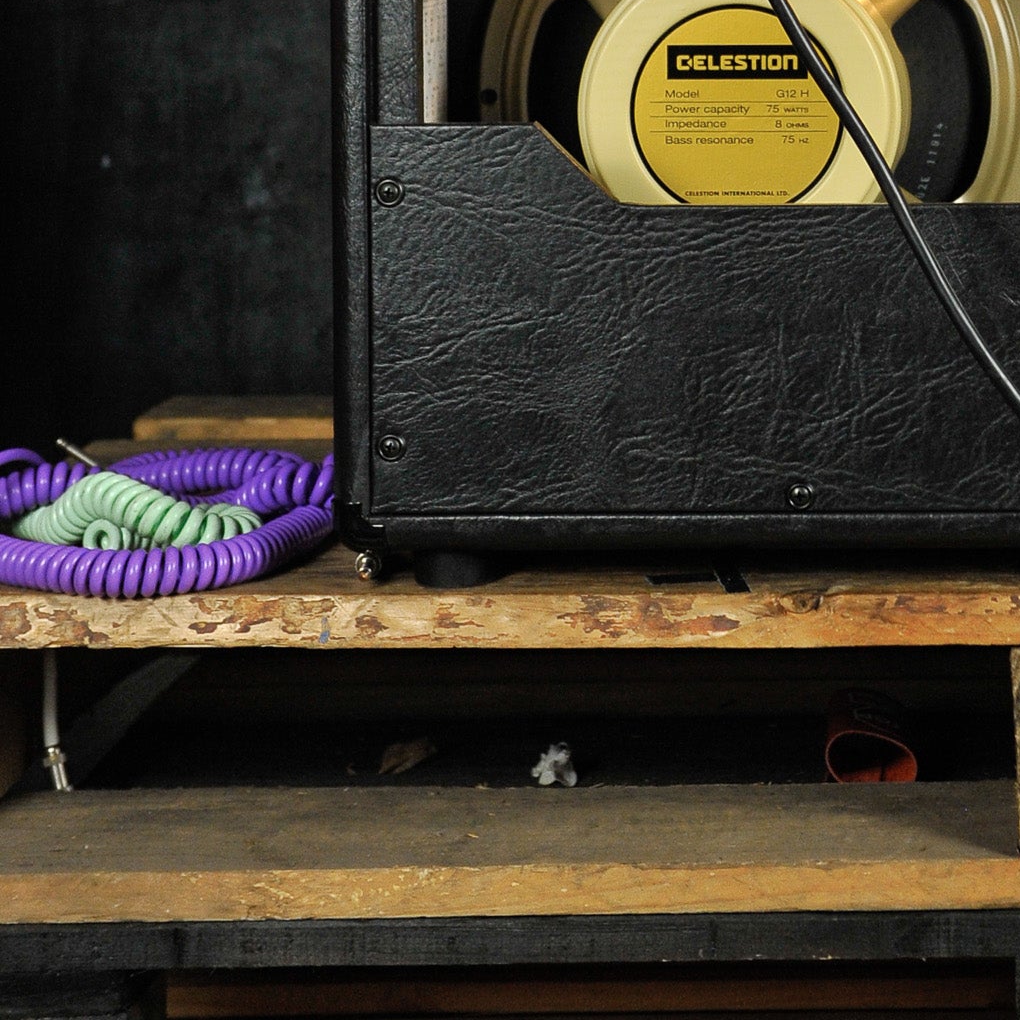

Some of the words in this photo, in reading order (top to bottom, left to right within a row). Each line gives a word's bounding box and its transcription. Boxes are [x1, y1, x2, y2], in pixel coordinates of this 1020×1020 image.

[676, 54, 798, 71] CELESTION
[665, 90, 700, 99] Model
[776, 89, 796, 98] G12
[665, 105, 700, 113] Power
[703, 105, 750, 115] capacity
[767, 105, 779, 113] 75
[665, 120, 727, 130] Impedance
[775, 120, 782, 128] 8
[665, 136, 692, 145] Bass
[695, 136, 754, 145] resonance
[782, 135, 795, 143] 75
